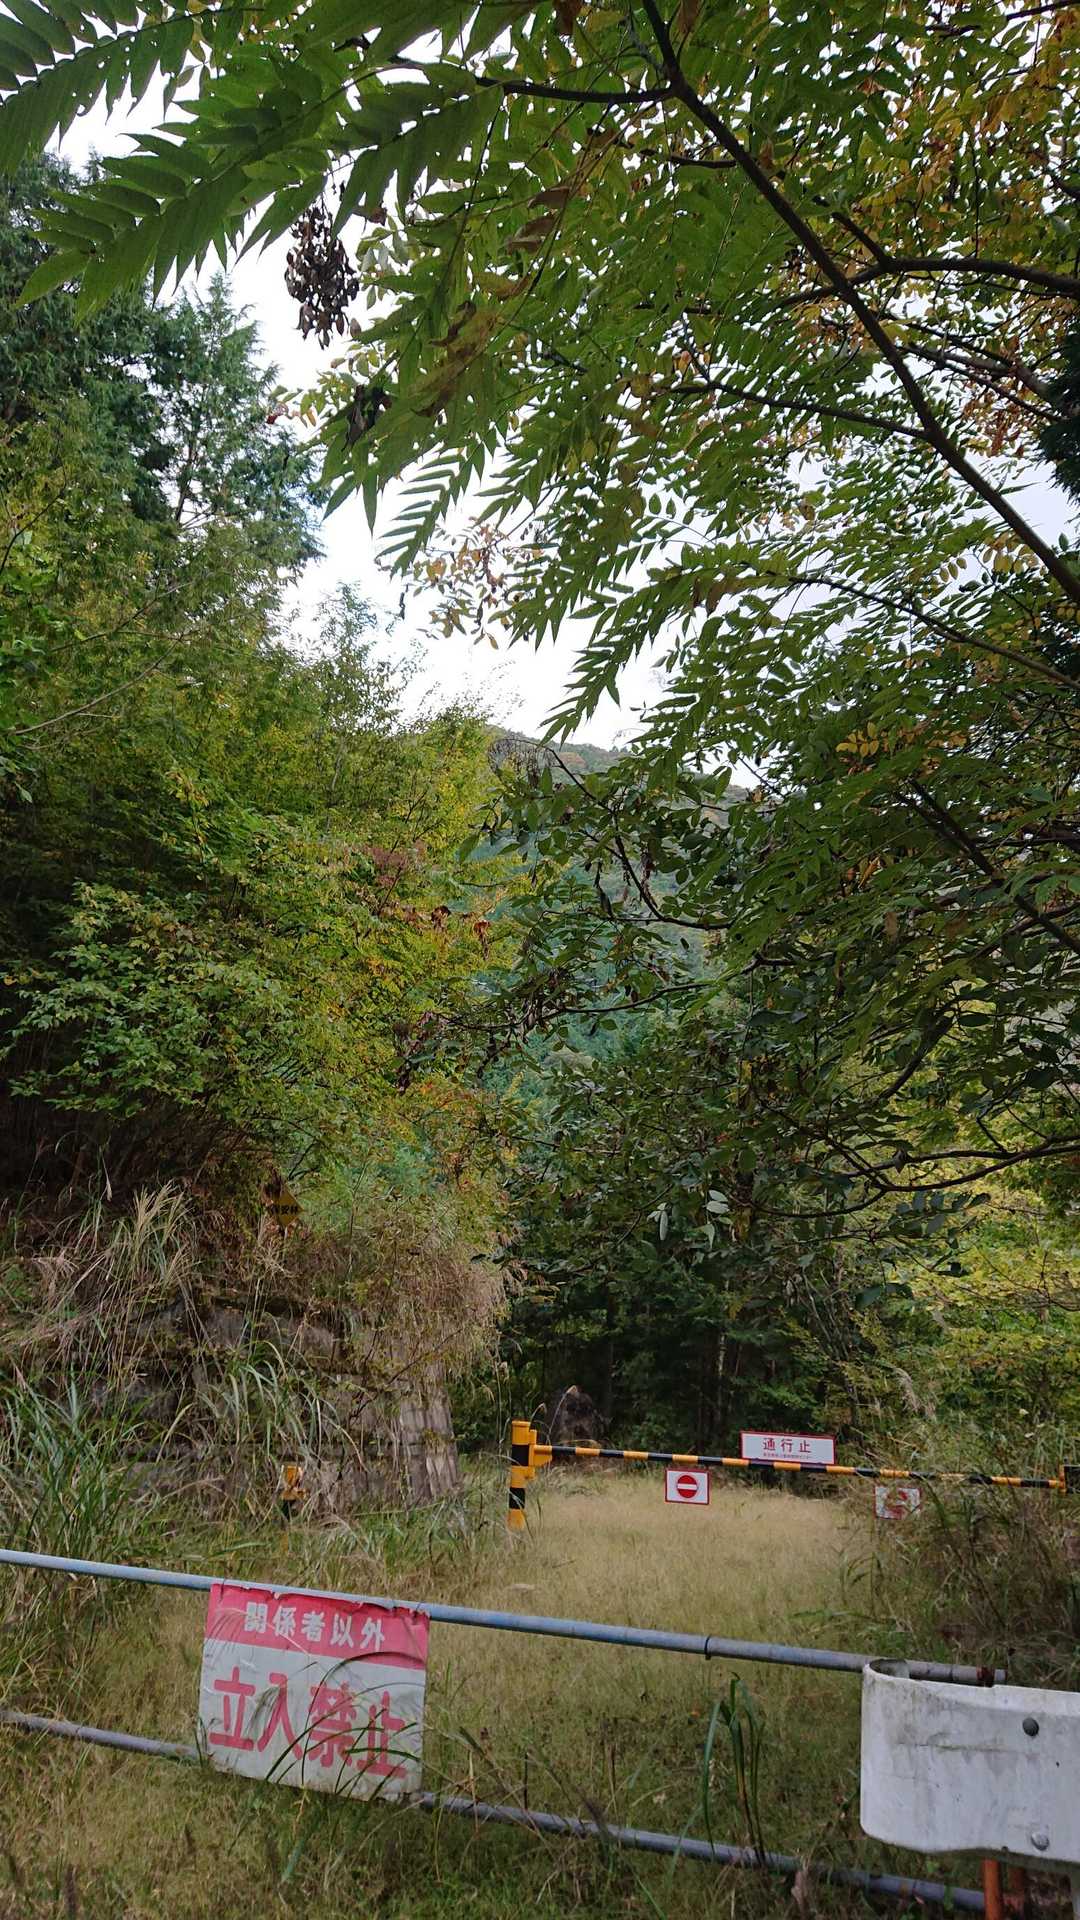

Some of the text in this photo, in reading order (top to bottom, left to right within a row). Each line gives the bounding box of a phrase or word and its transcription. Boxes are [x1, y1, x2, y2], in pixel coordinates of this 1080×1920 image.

[763, 1437, 811, 1453] 通行止
[244, 1601, 385, 1650] 関係者以外
[209, 1666, 407, 1777] 立入禁止
